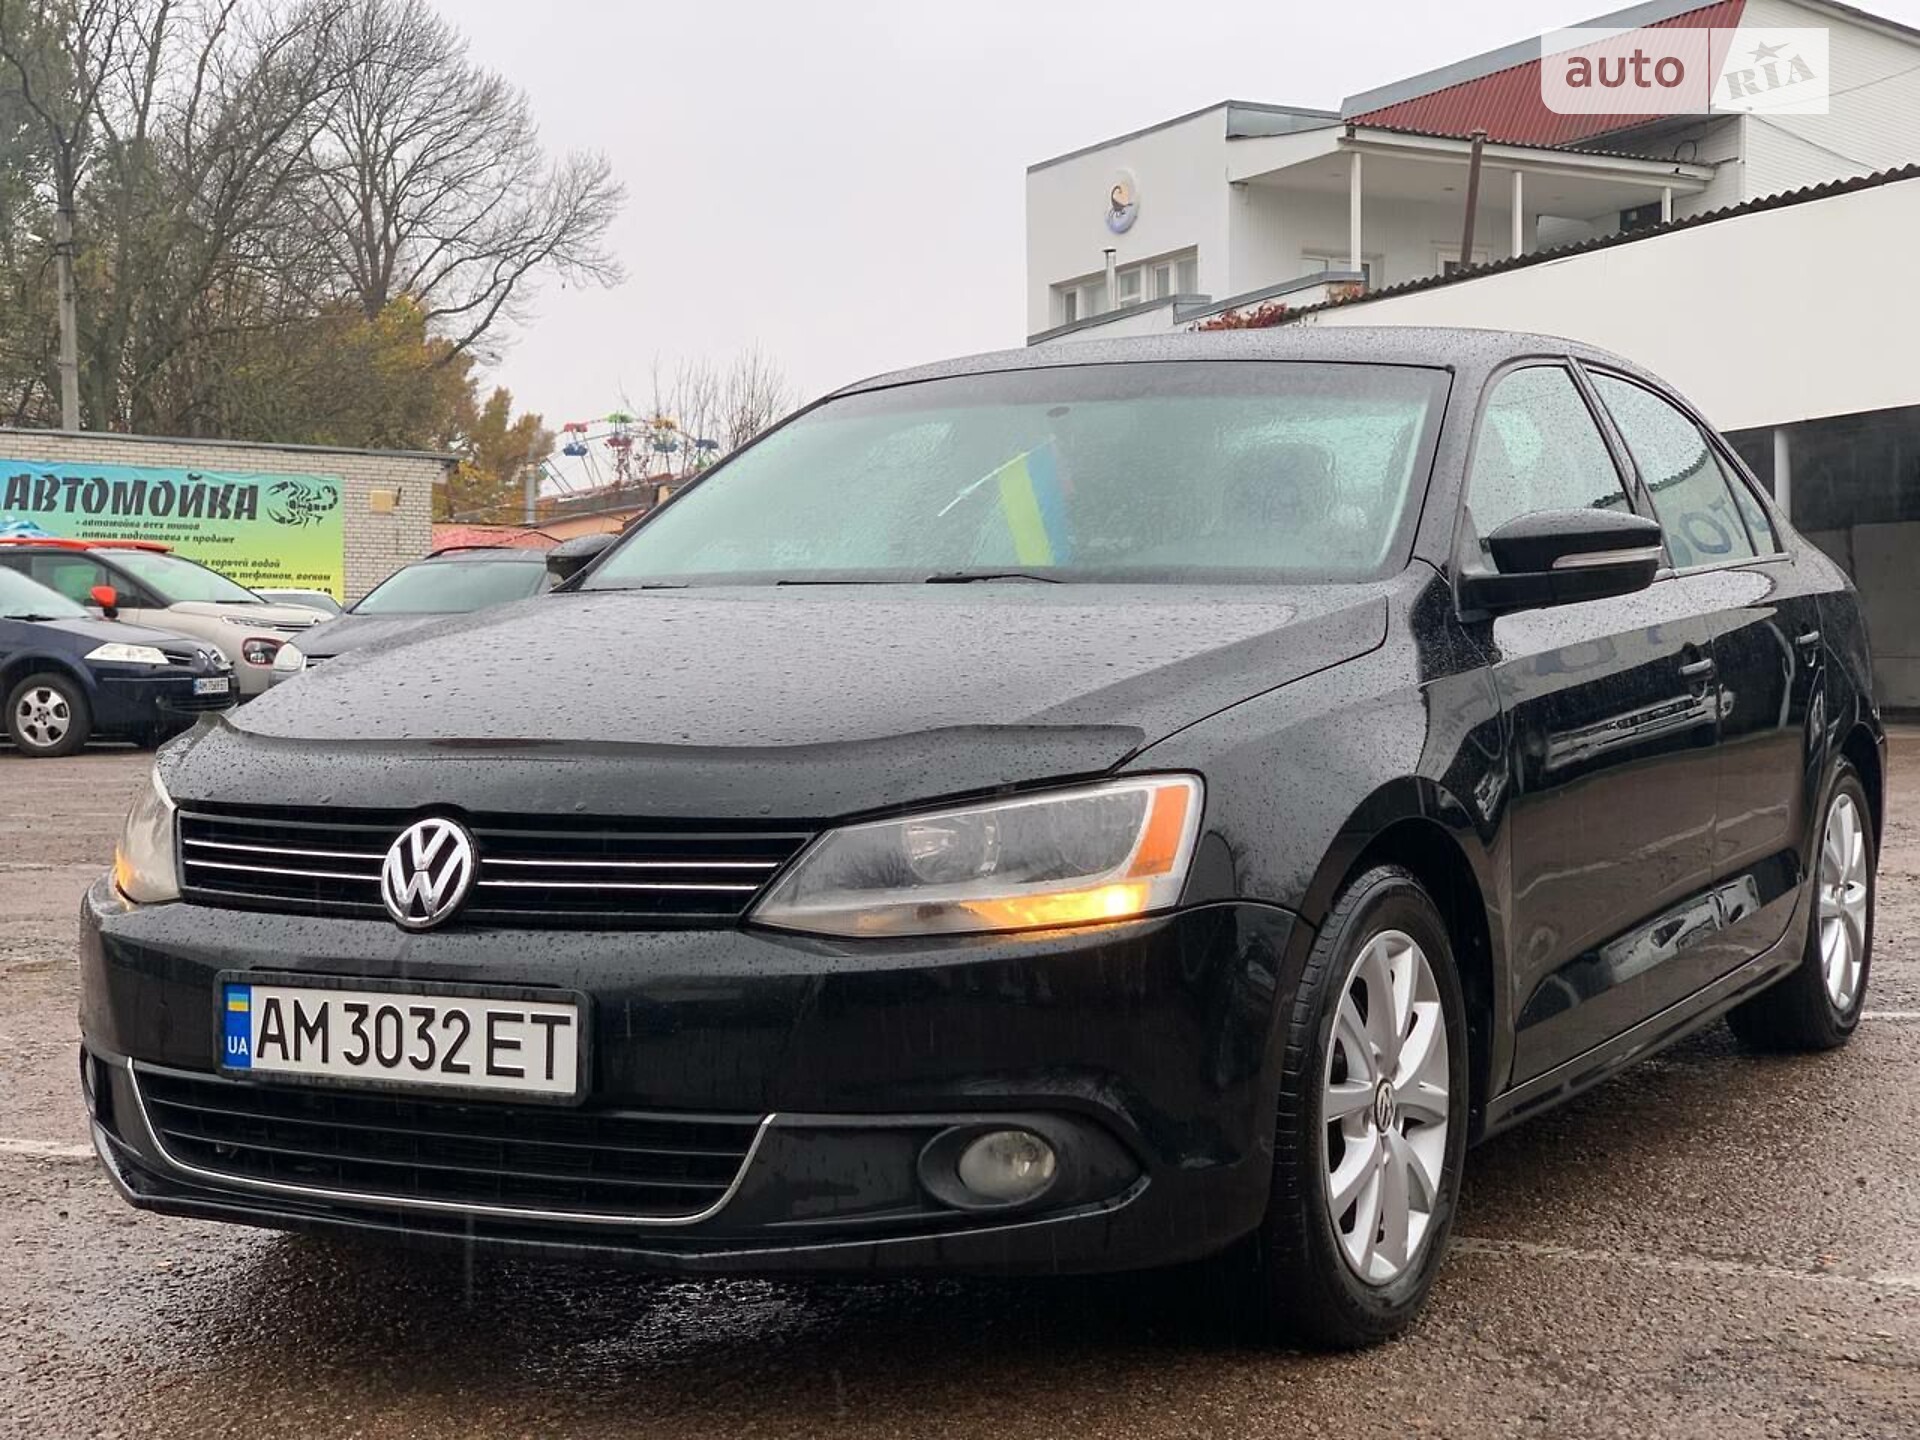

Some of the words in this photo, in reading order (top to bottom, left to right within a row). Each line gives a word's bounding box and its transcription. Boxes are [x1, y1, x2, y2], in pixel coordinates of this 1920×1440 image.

[4, 474, 257, 520] АВТОМОЙКА
[227, 1036, 249, 1056] UA
[256, 996, 330, 1064] AM
[342, 1002, 471, 1075] 3032
[485, 1011, 572, 1081] ET
